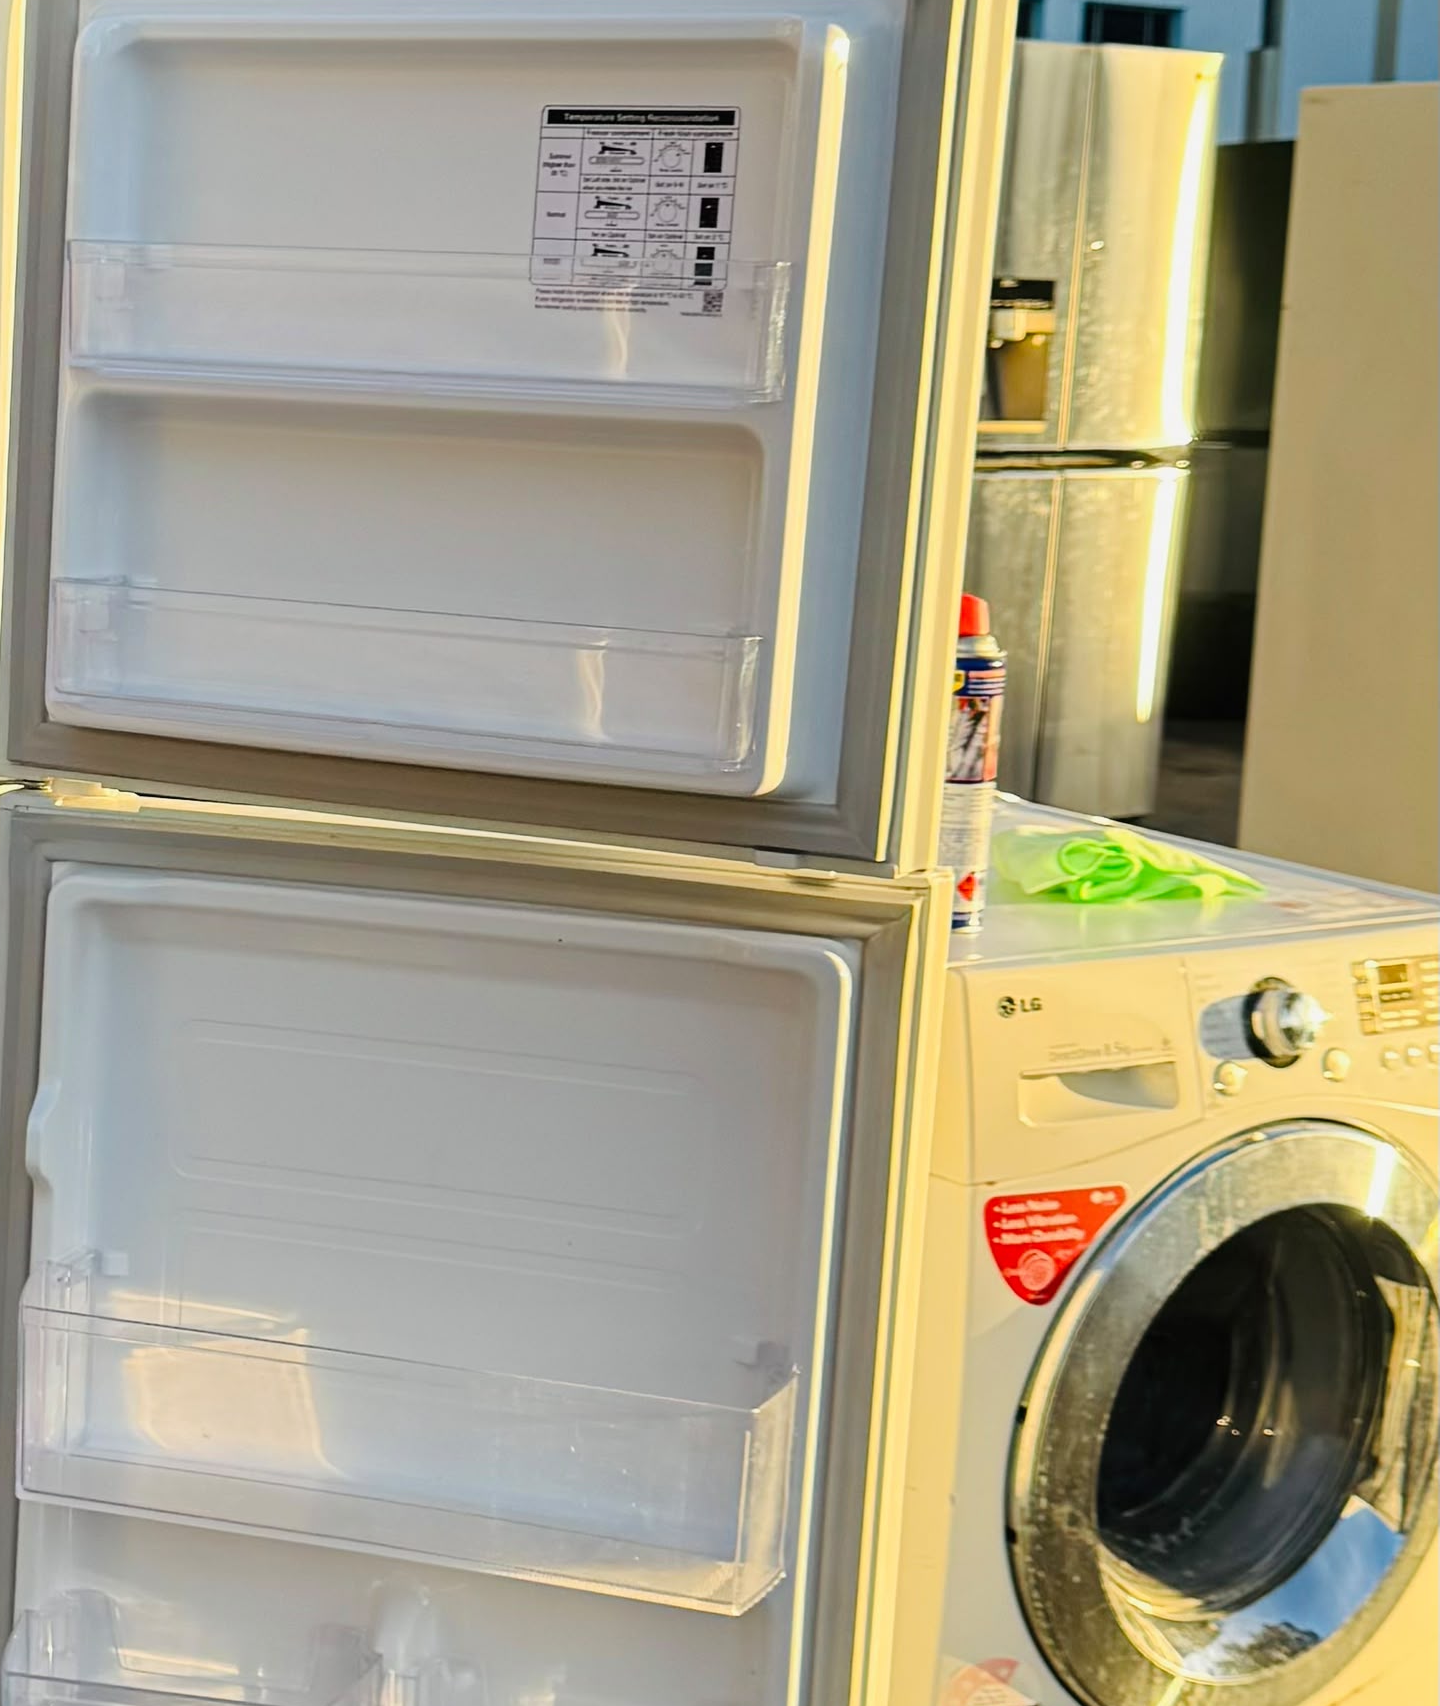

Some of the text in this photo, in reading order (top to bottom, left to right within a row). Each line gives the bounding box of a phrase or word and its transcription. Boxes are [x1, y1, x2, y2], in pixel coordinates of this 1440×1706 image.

[564, 113, 615, 123] Temperature
[617, 113, 646, 123] Setting
[1020, 997, 1042, 1012] LG
